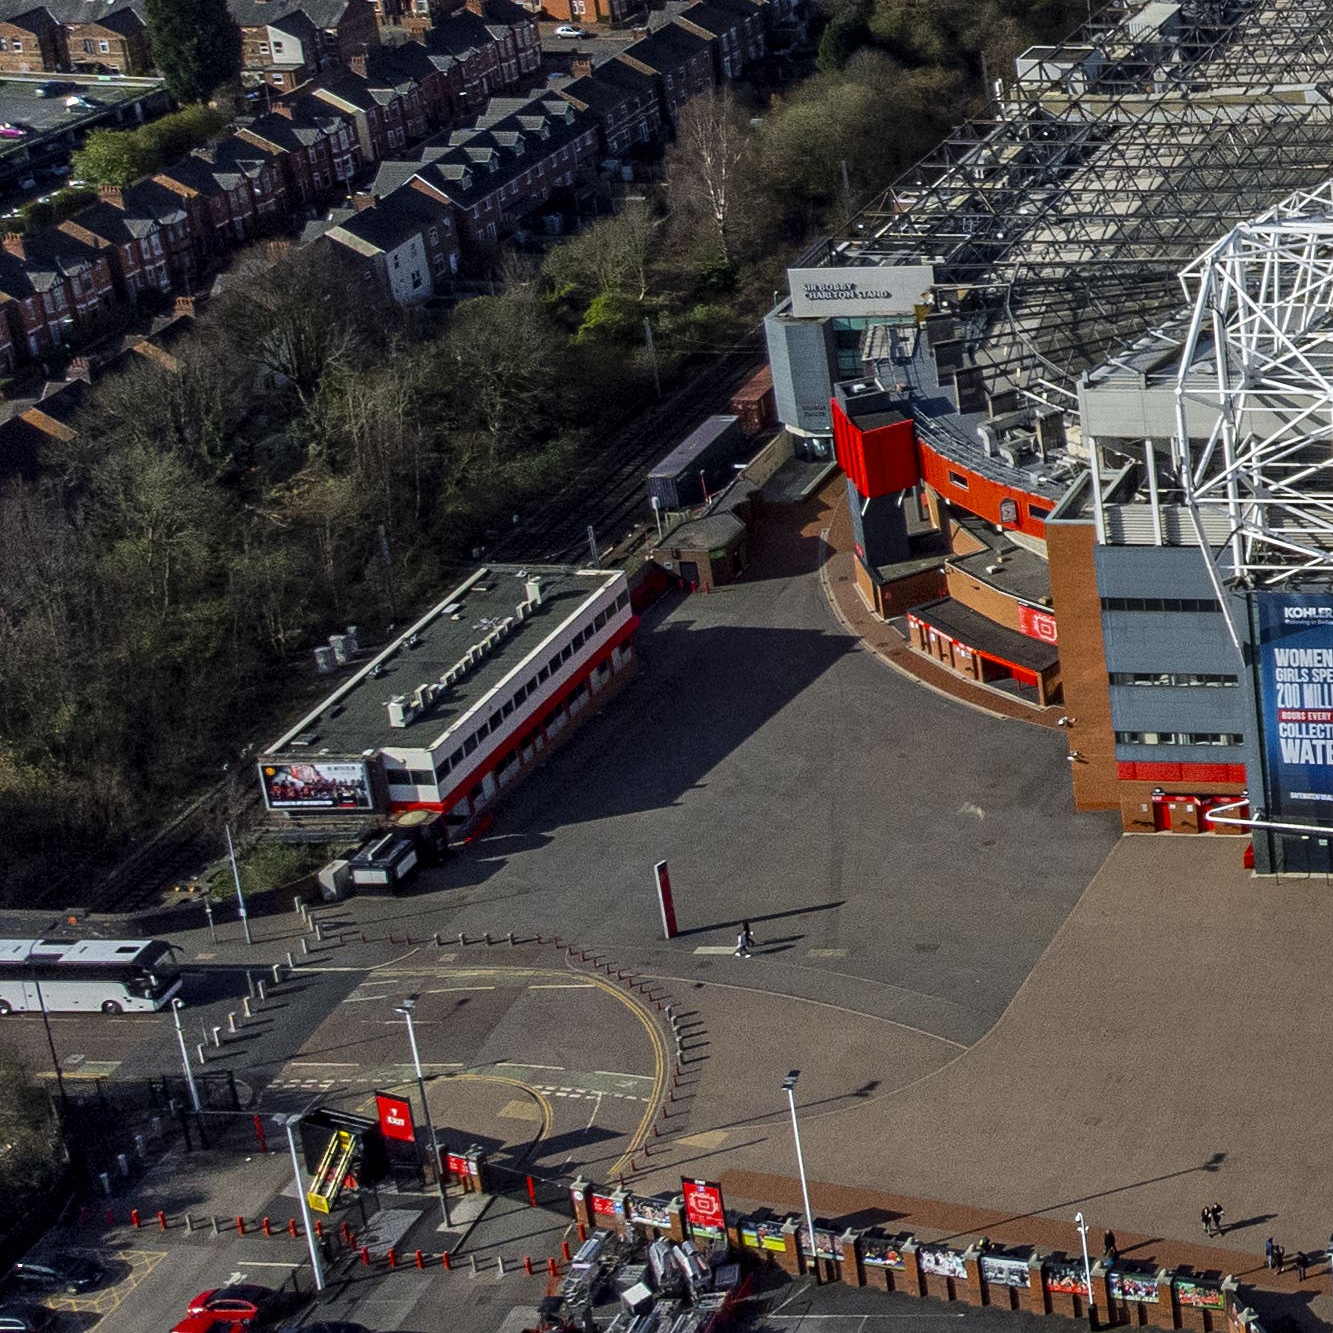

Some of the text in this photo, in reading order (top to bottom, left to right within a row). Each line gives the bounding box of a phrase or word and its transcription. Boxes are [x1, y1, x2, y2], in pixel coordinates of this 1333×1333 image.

[1284, 607, 1333, 619] KOHLER
[1274, 647, 1333, 668] WOMEN
[1275, 668, 1309, 683] GIRLS
[1277, 683, 1300, 709] 200
[1308, 712, 1332, 721] EVERY
